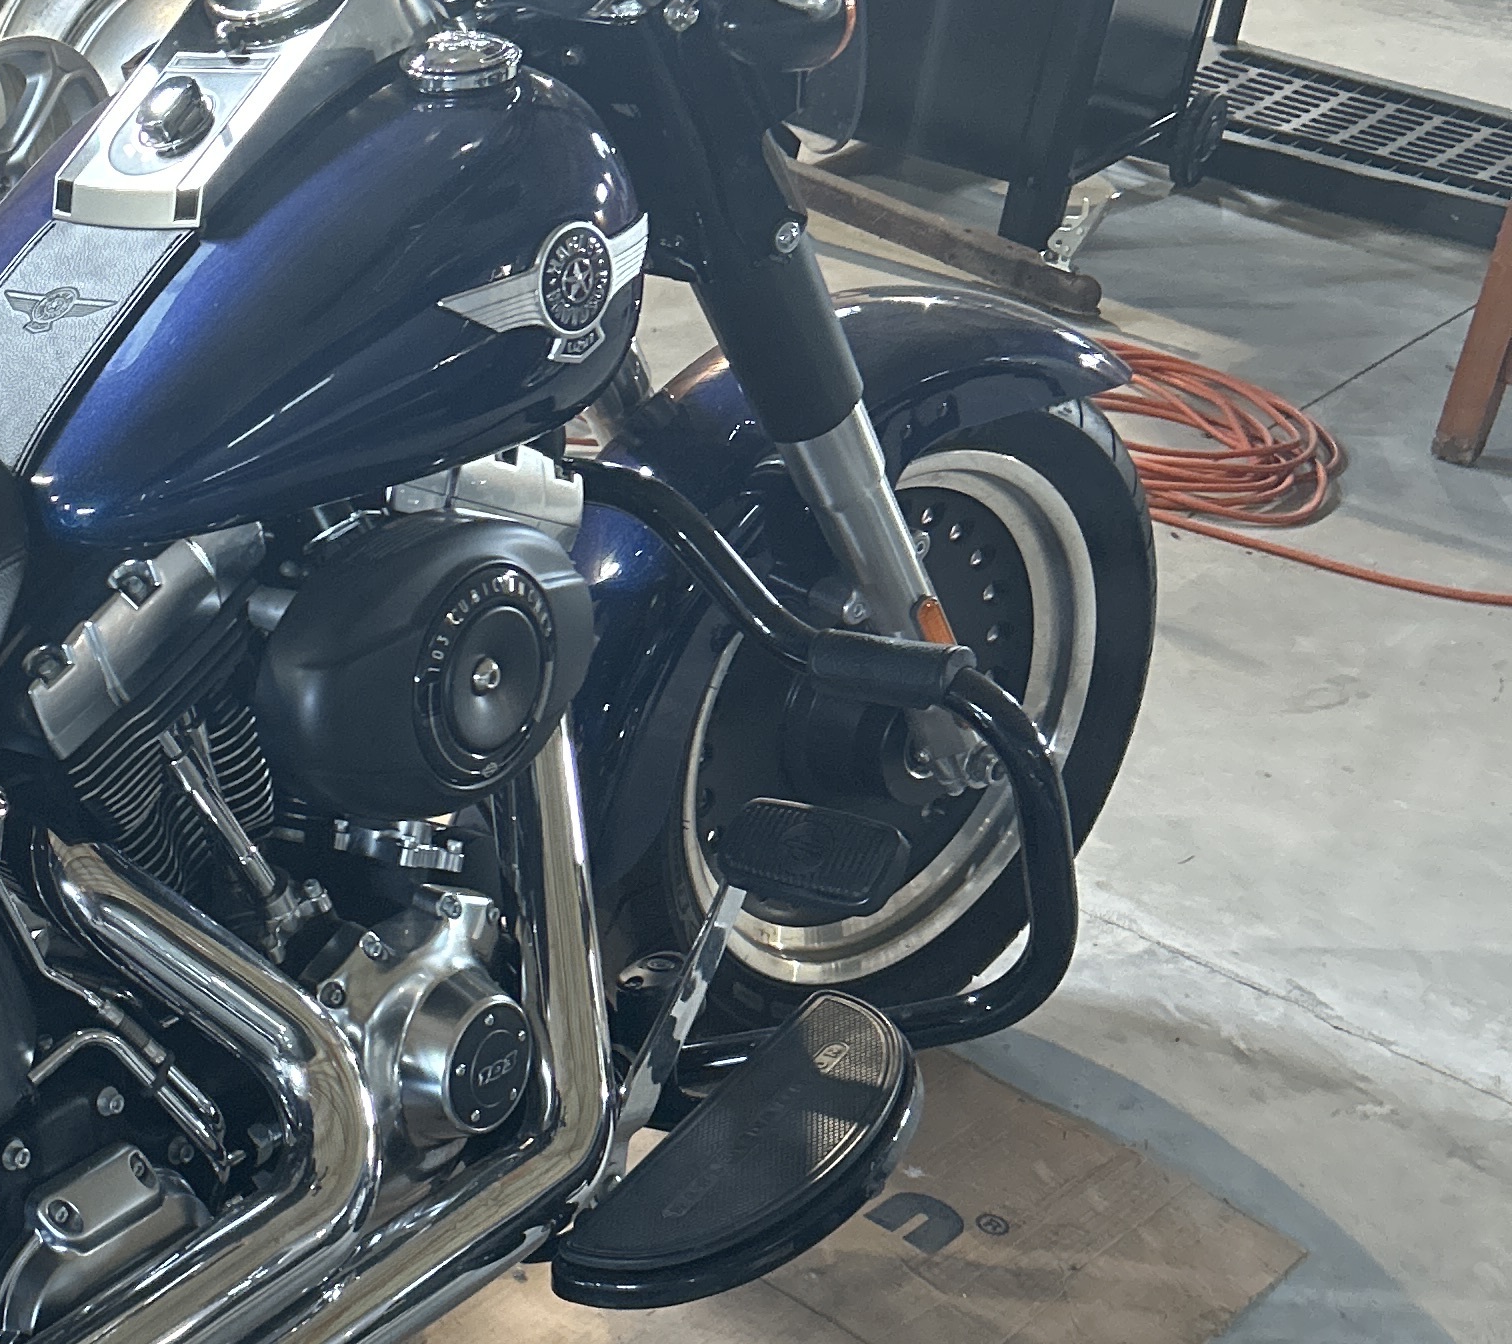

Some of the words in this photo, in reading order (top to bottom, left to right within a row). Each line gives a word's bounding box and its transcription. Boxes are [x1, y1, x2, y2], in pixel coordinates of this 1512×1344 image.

[427, 635, 450, 673] 103
[446, 577, 502, 626] CUBIC
[477, 1049, 519, 1087] 103
